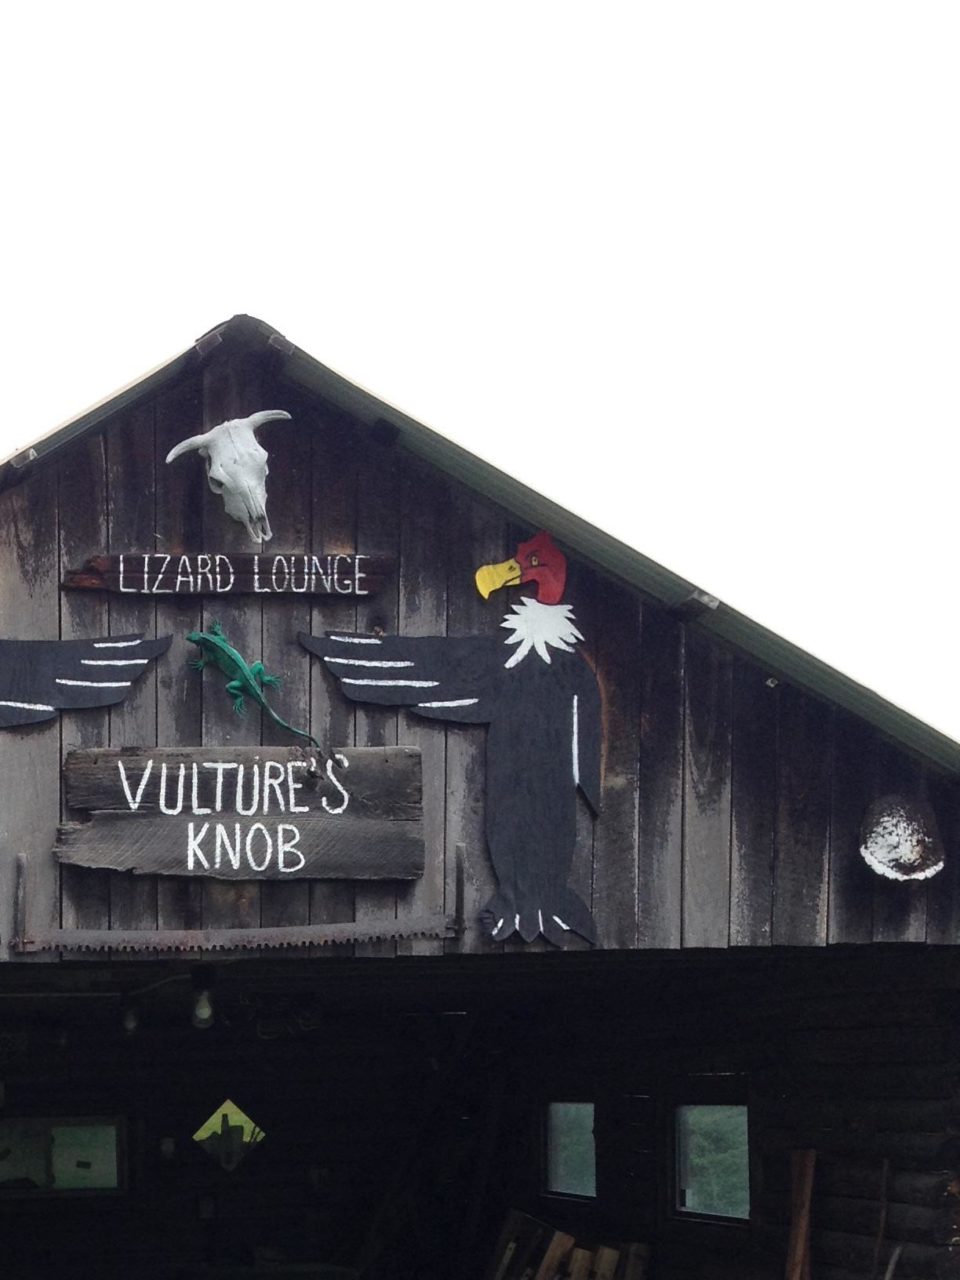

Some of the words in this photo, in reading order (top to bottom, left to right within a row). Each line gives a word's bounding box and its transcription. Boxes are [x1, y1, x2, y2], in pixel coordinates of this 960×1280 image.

[118, 553, 235, 594] LIZARD
[253, 554, 370, 594] LOUNGE
[118, 754, 350, 816] VULTURE'S
[187, 822, 306, 873] KNOB
